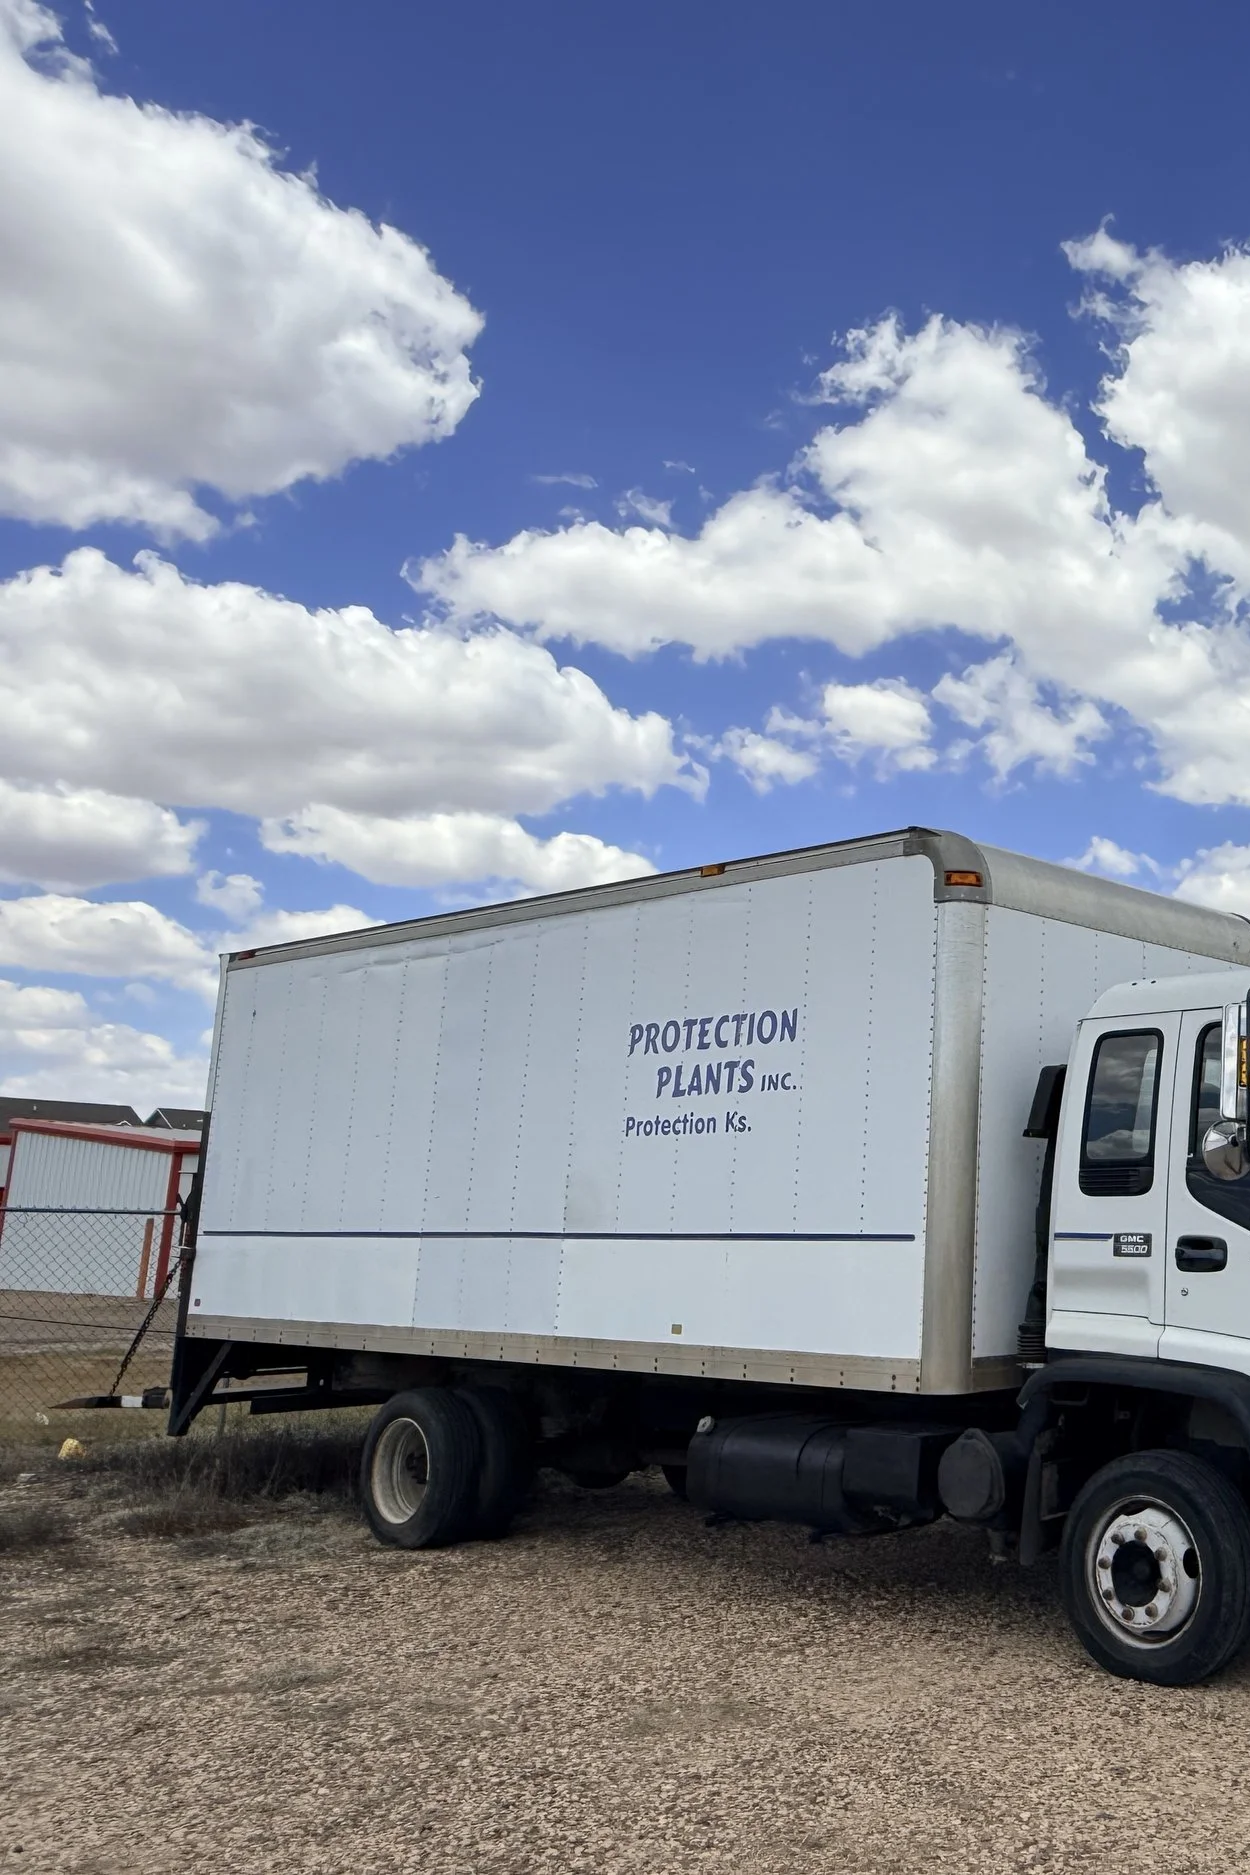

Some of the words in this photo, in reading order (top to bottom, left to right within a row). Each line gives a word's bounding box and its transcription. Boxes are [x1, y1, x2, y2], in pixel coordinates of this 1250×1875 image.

[627, 1008, 798, 1057] PROTECTION
[656, 1059, 755, 1098] PLANTS
[760, 1072, 797, 1092] INC.
[625, 1112, 717, 1137] Protection
[725, 1111, 752, 1133] Ks.
[1120, 1235, 1145, 1243] GMC
[1120, 1244, 1148, 1253] 5500
